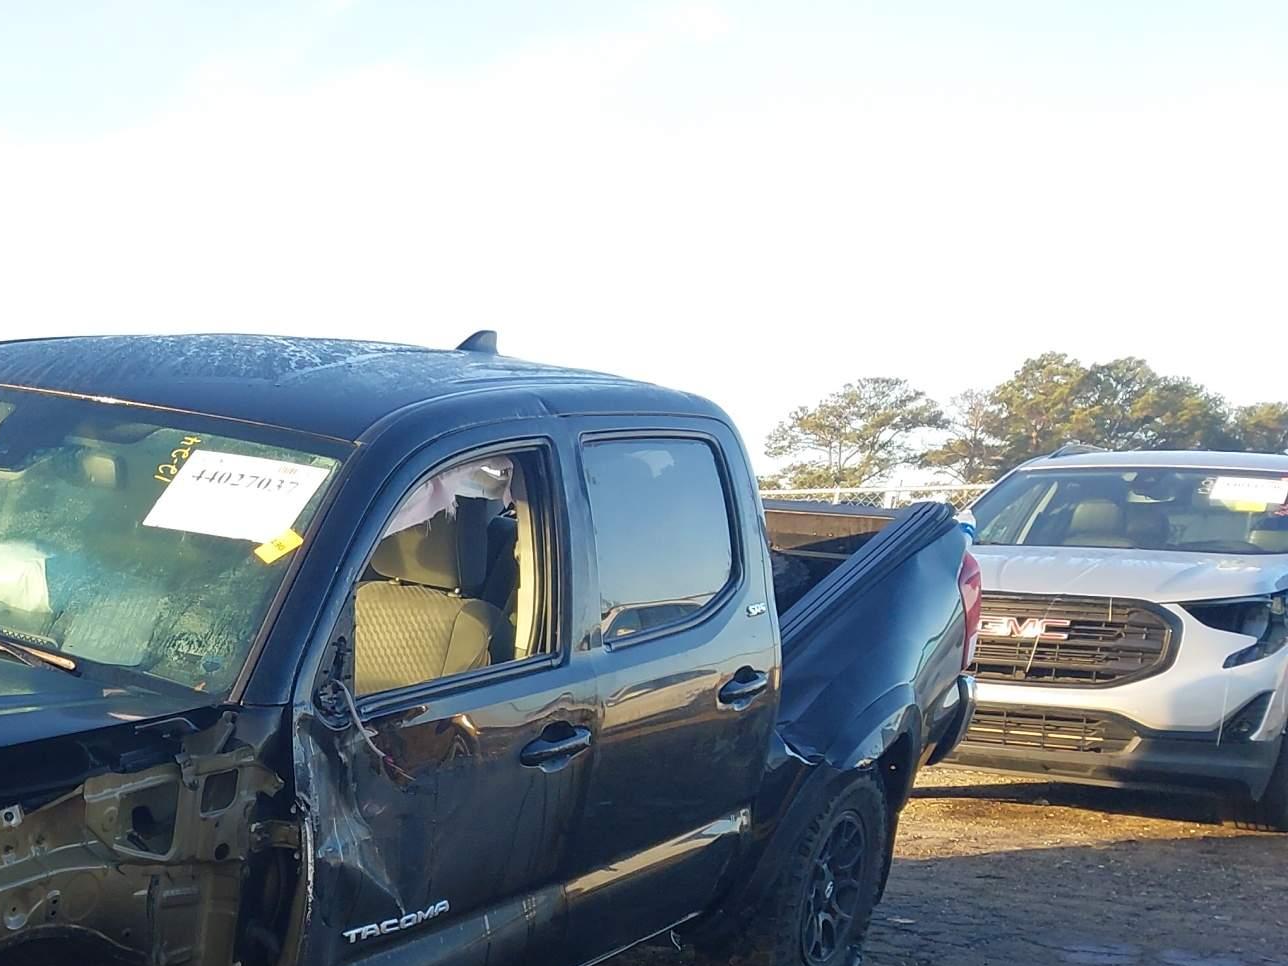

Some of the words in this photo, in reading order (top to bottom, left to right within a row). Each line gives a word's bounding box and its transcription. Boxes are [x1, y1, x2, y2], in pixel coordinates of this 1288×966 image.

[154, 436, 202, 482] 12-24
[191, 468, 300, 494] 44027037
[977, 615, 1071, 640] GMC
[342, 899, 450, 943] TACOMA
